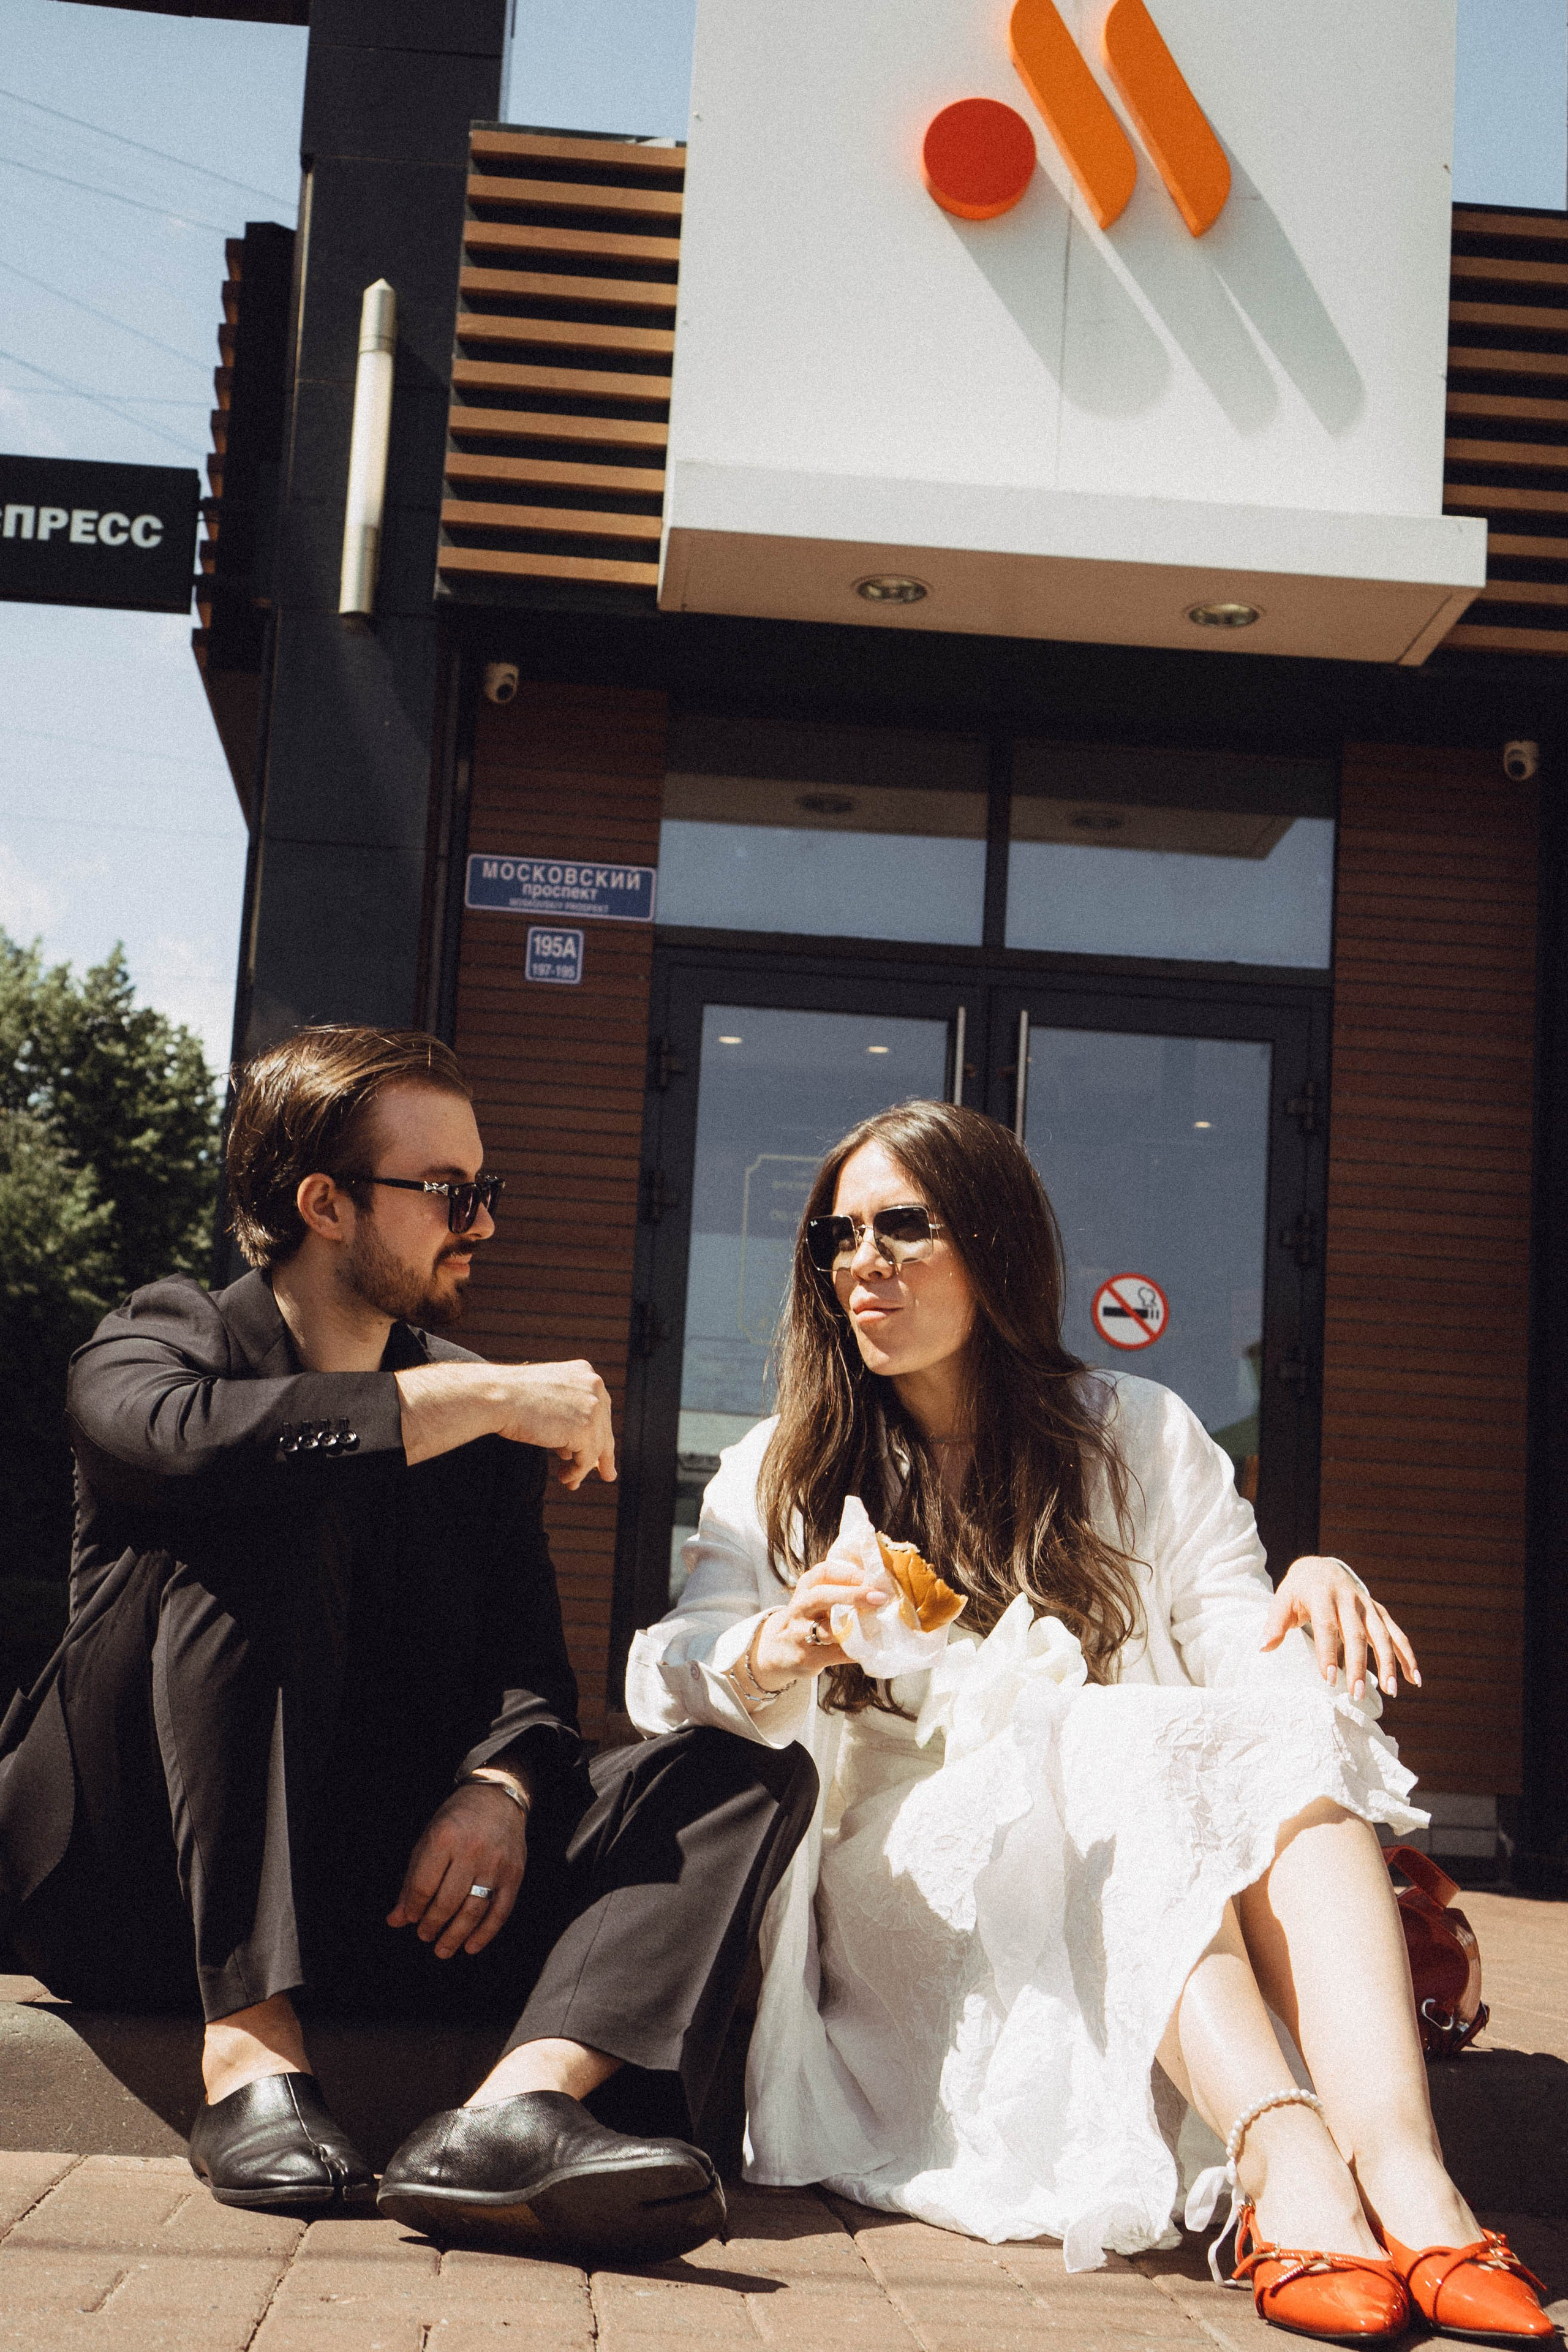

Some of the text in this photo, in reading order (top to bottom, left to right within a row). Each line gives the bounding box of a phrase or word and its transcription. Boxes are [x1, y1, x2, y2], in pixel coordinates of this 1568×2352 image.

[0, 503, 164, 548] ПРЕСС
[482, 861, 641, 891] МОСКОВСКИЙ
[522, 883, 598, 900] проспект
[533, 935, 577, 959] 195А
